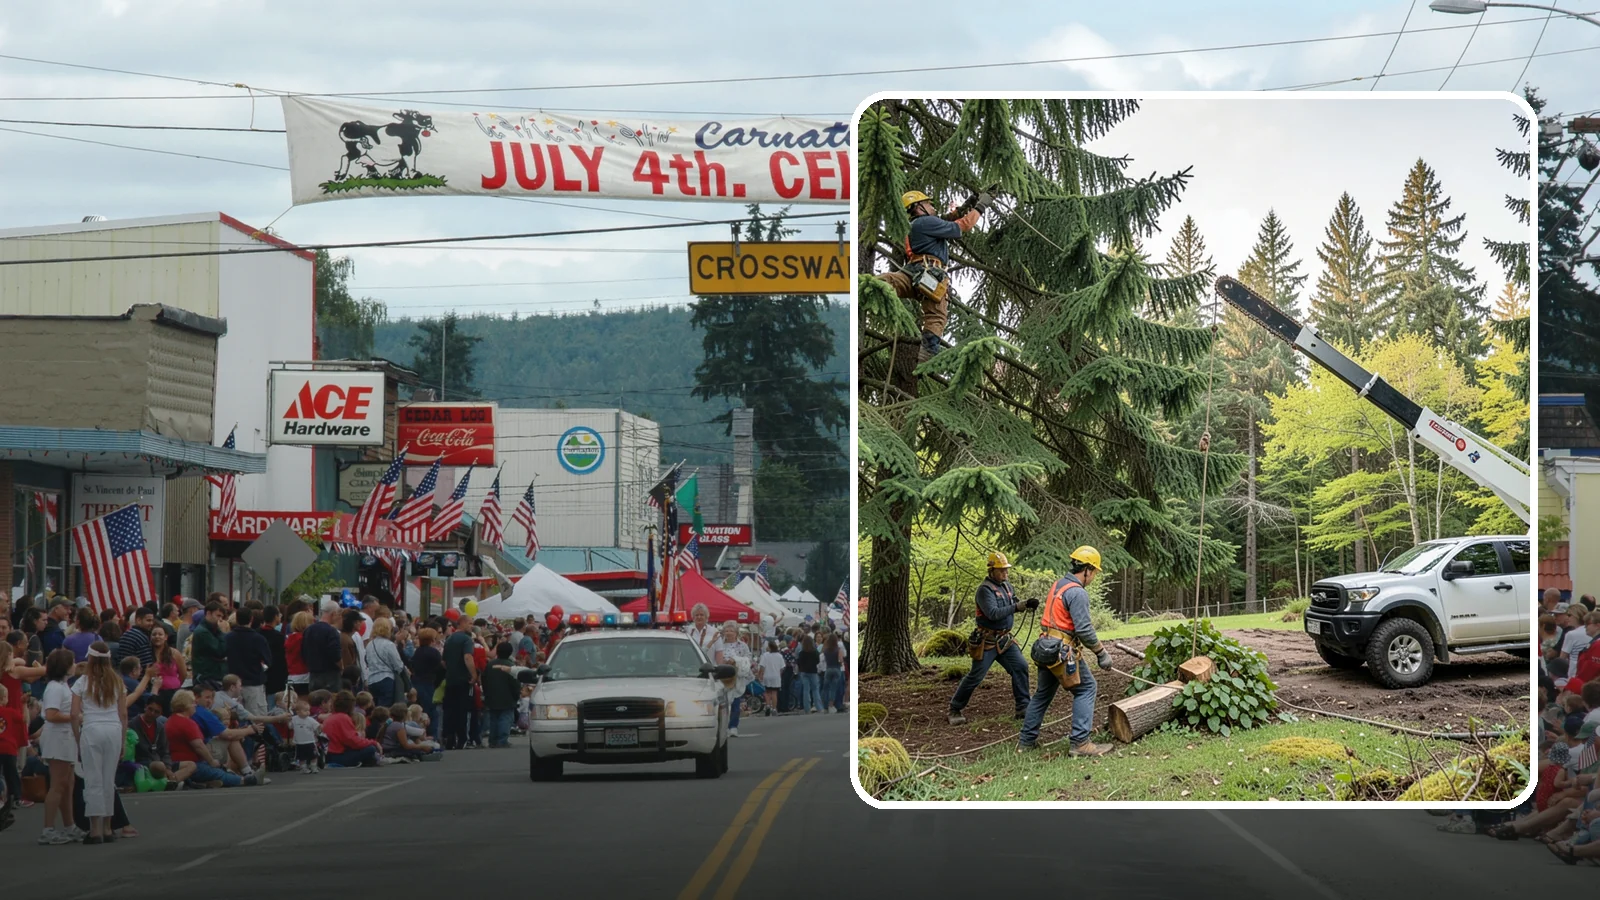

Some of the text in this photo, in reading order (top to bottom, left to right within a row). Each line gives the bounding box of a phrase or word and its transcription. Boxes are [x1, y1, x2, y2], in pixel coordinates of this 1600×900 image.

[695, 121, 850, 150] Carnat
[481, 141, 605, 192] JULY
[632, 150, 746, 198] 4th.
[697, 254, 850, 280] CROSSWA
[282, 380, 374, 419] ACE
[406, 409, 452, 422] CEDAR
[283, 421, 371, 436] Hardware
[416, 428, 476, 447] Coca-Cola
[95, 485, 124, 495] Vincent
[126, 486, 136, 495] de
[137, 485, 155, 495] Paul
[688, 526, 741, 535] CRNATION
[699, 535, 730, 544] GLASS
